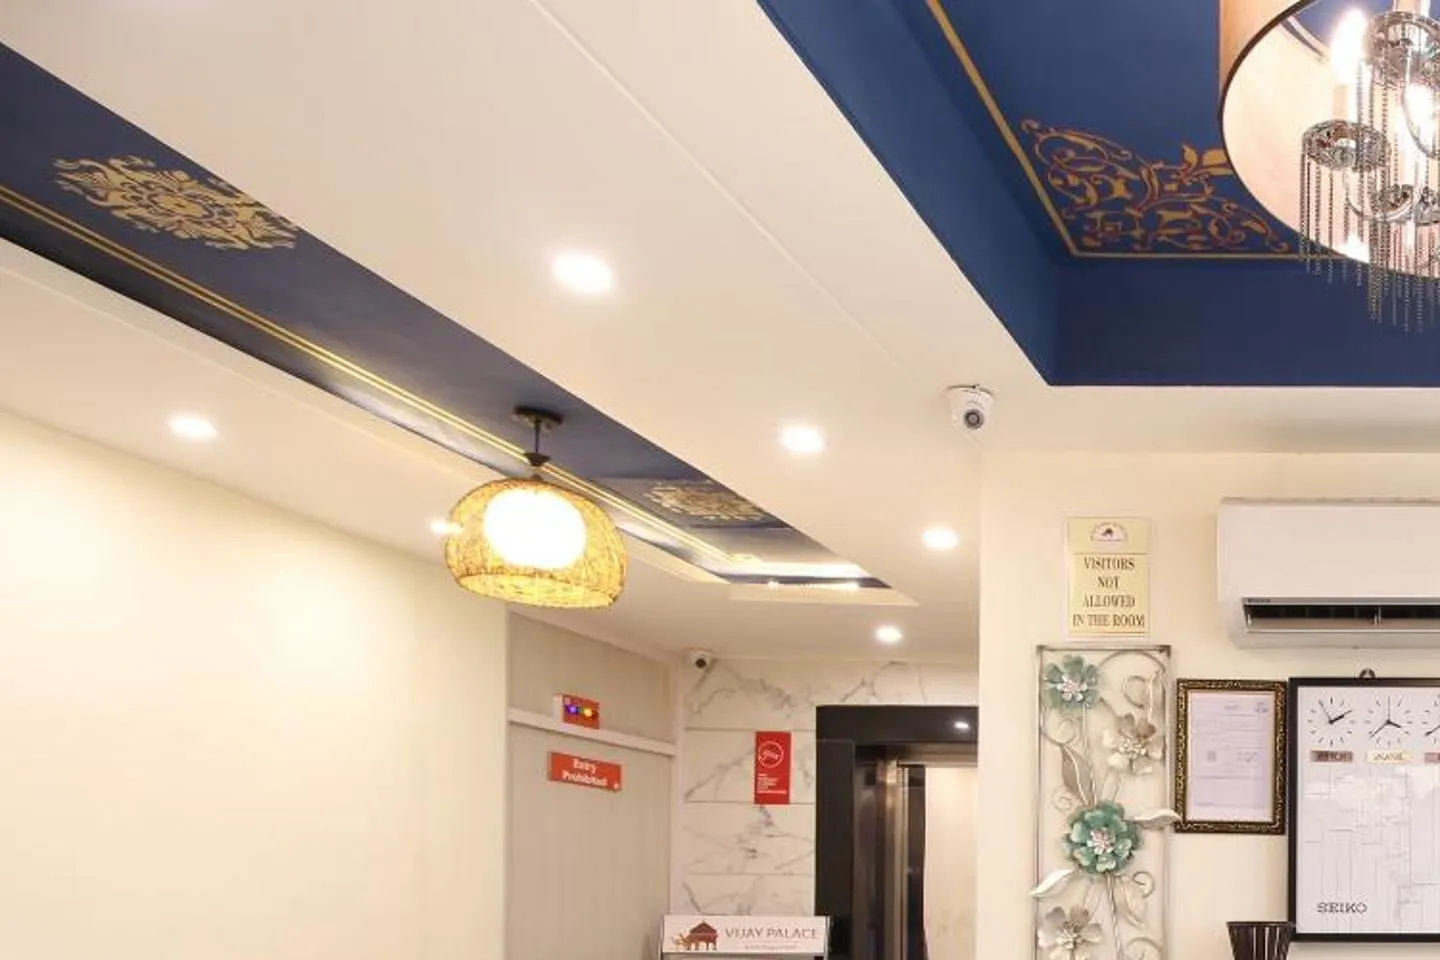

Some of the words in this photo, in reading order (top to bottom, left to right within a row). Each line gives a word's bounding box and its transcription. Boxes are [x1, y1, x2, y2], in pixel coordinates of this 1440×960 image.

[1084, 557, 1135, 570] VISITORS
[1097, 576, 1119, 588] NOT
[1082, 594, 1136, 607] ALLOWED
[1072, 614, 1084, 627] IN
[1087, 614, 1110, 627] THE
[1112, 614, 1145, 627] ROOM
[1316, 902, 1368, 914] SEIKO
[725, 927, 764, 939] VIJAY
[766, 927, 817, 939] PALACE
